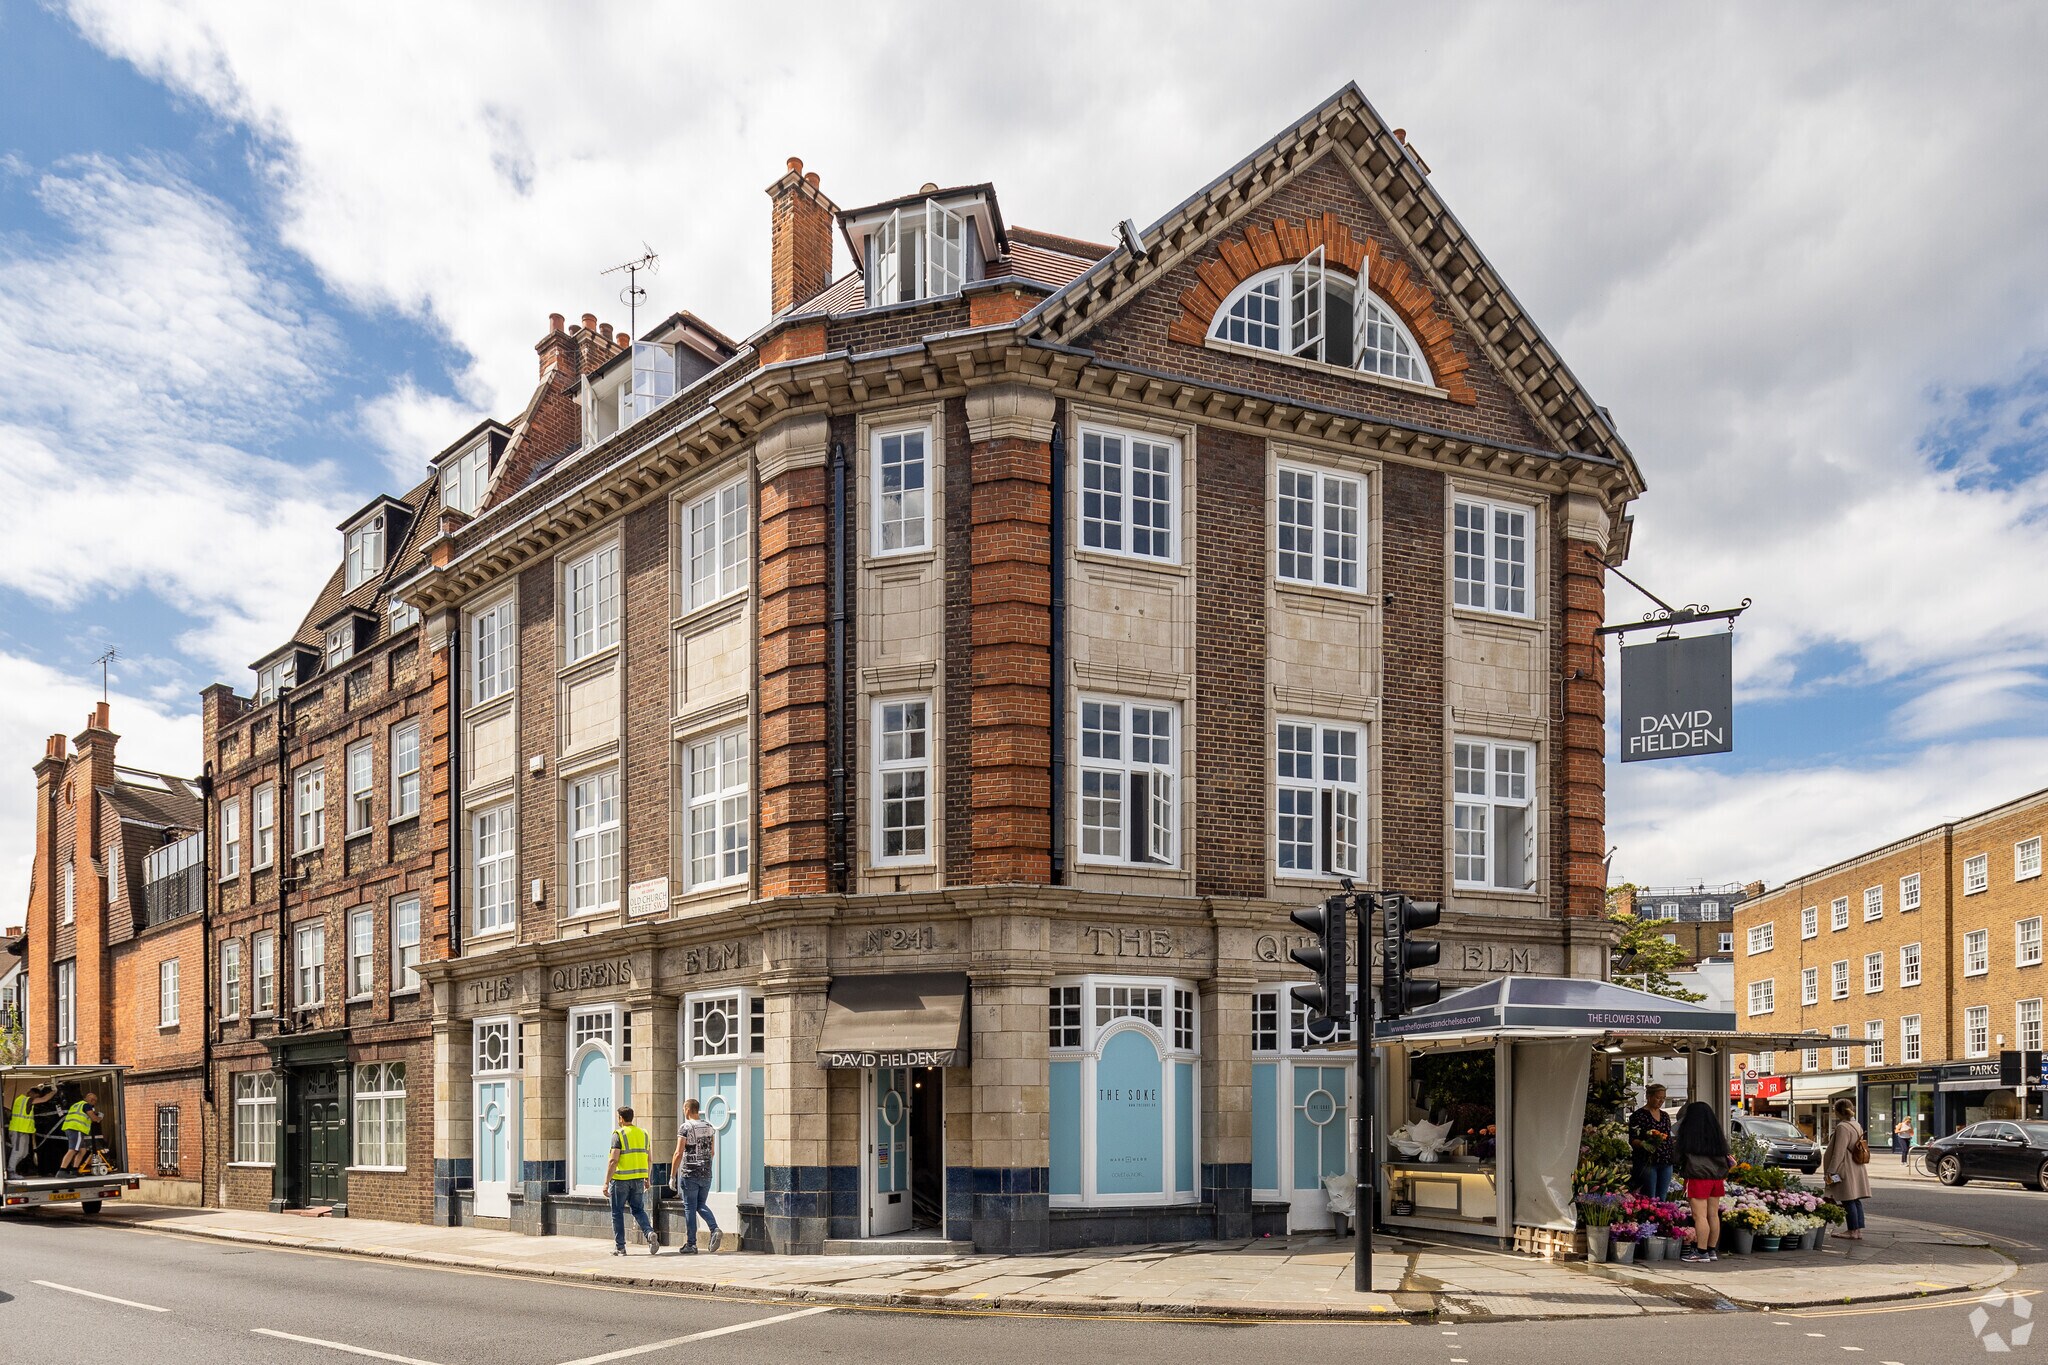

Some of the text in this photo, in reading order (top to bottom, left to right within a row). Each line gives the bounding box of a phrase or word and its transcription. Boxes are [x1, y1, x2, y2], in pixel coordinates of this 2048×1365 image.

[1640, 709, 1713, 734] DAVID
[1630, 727, 1723, 754] FIELDEN
[630, 896, 642, 907] OLD
[642, 891, 668, 905] CHURCH
[631, 903, 652, 915] STREET
[1084, 925, 1172, 958] THE
[1462, 945, 1533, 973] ELM
[469, 942, 742, 1005] THE QUEENS ELM
[1390, 1015, 1481, 1033] www.theflowerstandchelsea.com
[1587, 1013, 1662, 1025] THE FLOWER STAND
[832, 1051, 937, 1067] DAVID FIELDEN
[578, 1097, 610, 1108] THE SOKE
[1099, 1089, 1156, 1101] THE SOKE
